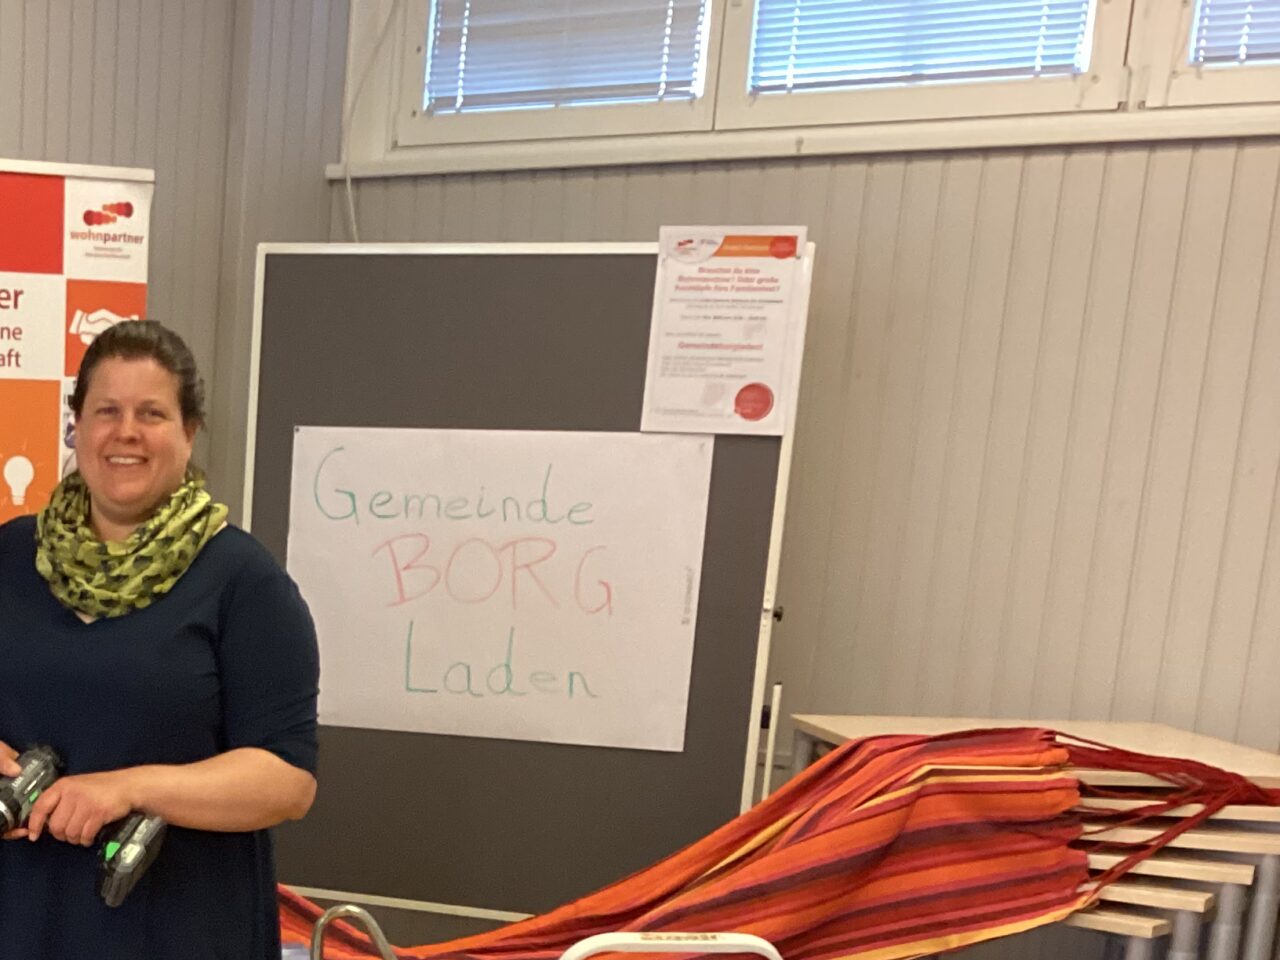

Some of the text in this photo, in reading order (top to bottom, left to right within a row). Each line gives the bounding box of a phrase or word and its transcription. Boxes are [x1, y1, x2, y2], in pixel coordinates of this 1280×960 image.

[70, 229, 144, 244] wohnpartner
[314, 447, 595, 526] Gemeinde
[372, 532, 614, 616] BORG
[404, 620, 599, 699] Laden
